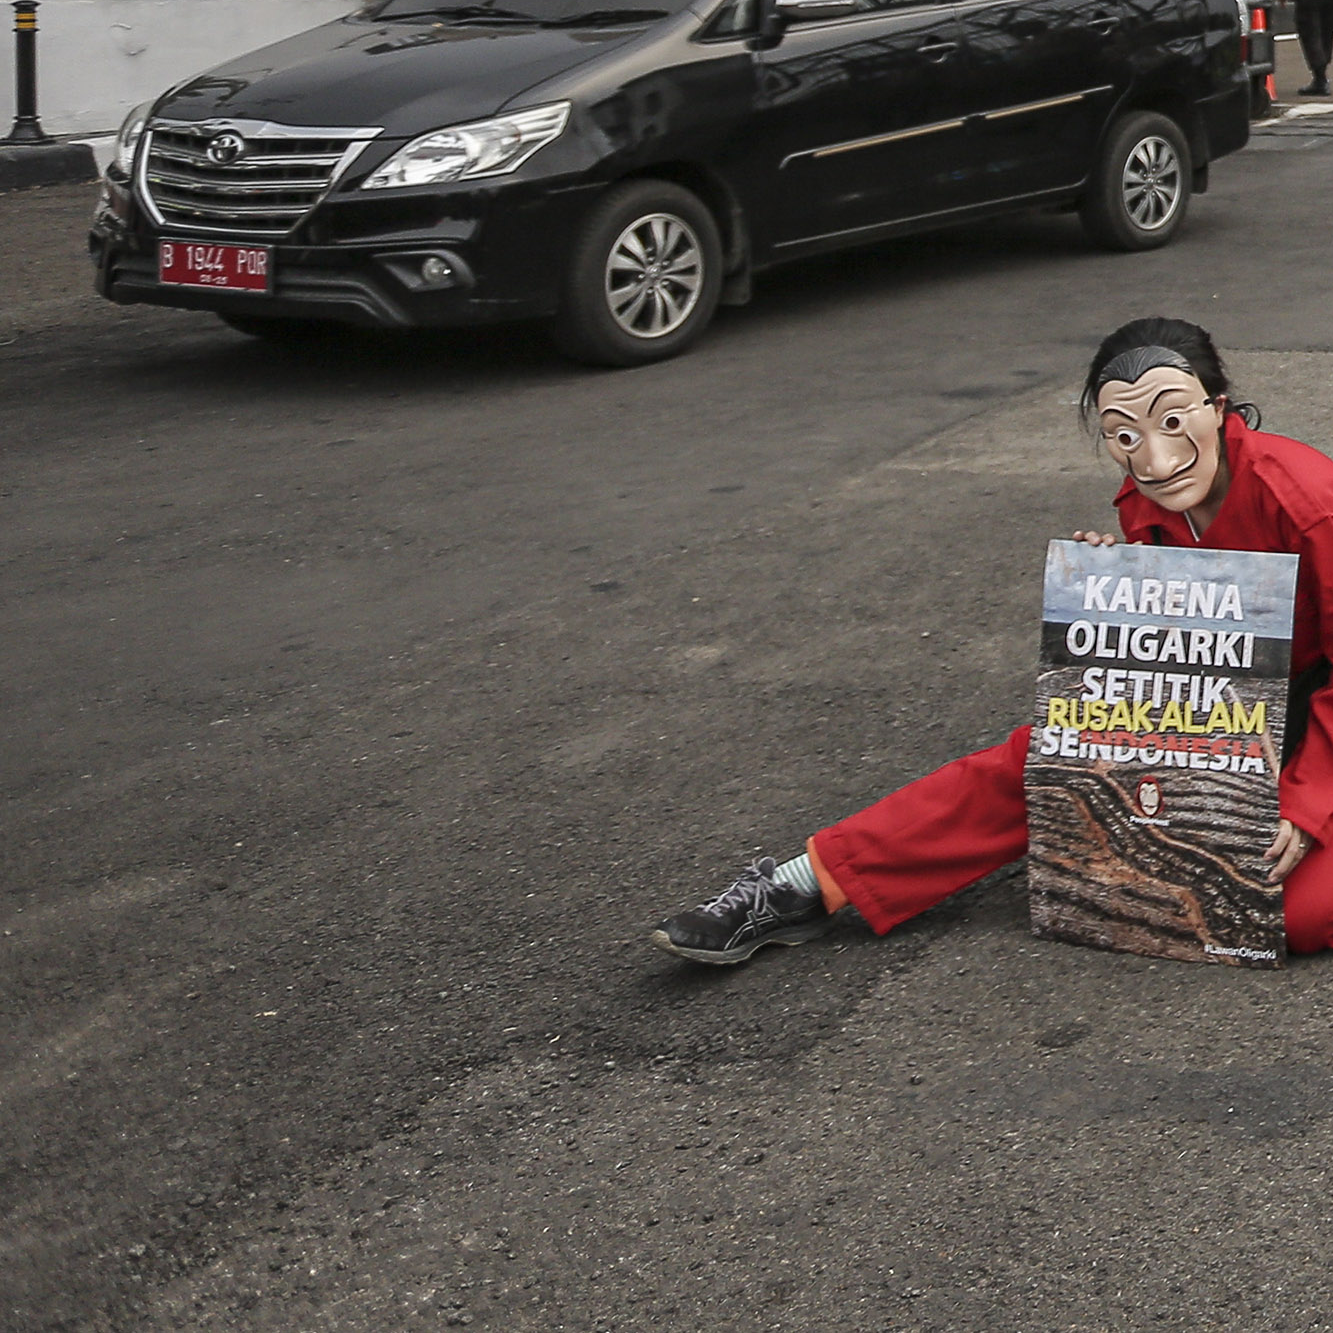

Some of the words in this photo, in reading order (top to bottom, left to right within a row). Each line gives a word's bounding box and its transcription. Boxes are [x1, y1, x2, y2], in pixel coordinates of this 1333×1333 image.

[163, 244, 173, 268] B
[186, 245, 225, 271] 1944
[1083, 574, 1244, 622] KARENA
[1065, 620, 1255, 669] OLIGARKI
[1081, 666, 1231, 713] SETITIK
[1047, 697, 1154, 733] RUSAK
[1159, 699, 1266, 735] ALAM
[1040, 726, 1266, 775] SEINDONESIA
